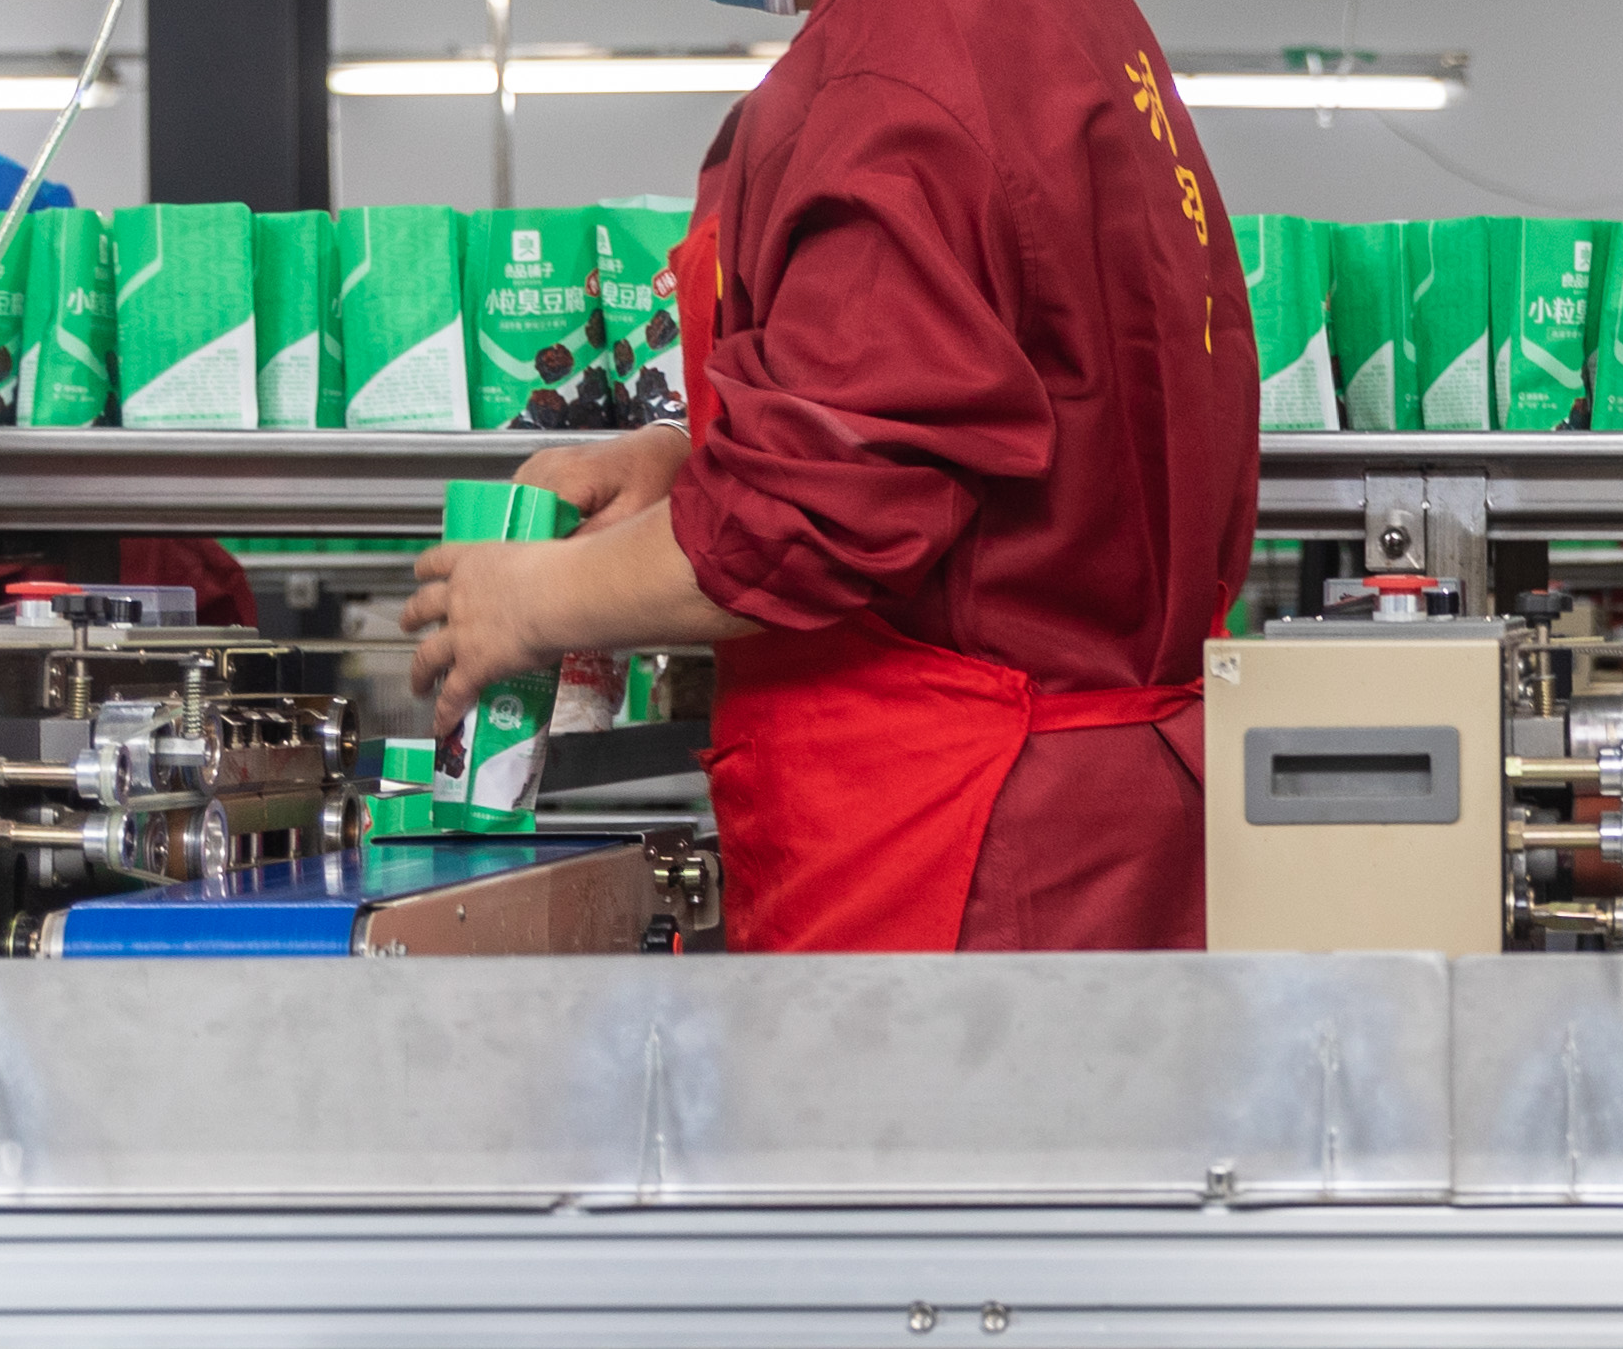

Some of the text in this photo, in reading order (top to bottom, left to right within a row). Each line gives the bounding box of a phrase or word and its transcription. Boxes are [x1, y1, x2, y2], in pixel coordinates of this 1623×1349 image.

[485, 286, 586, 315] 小粒臭豆腐
